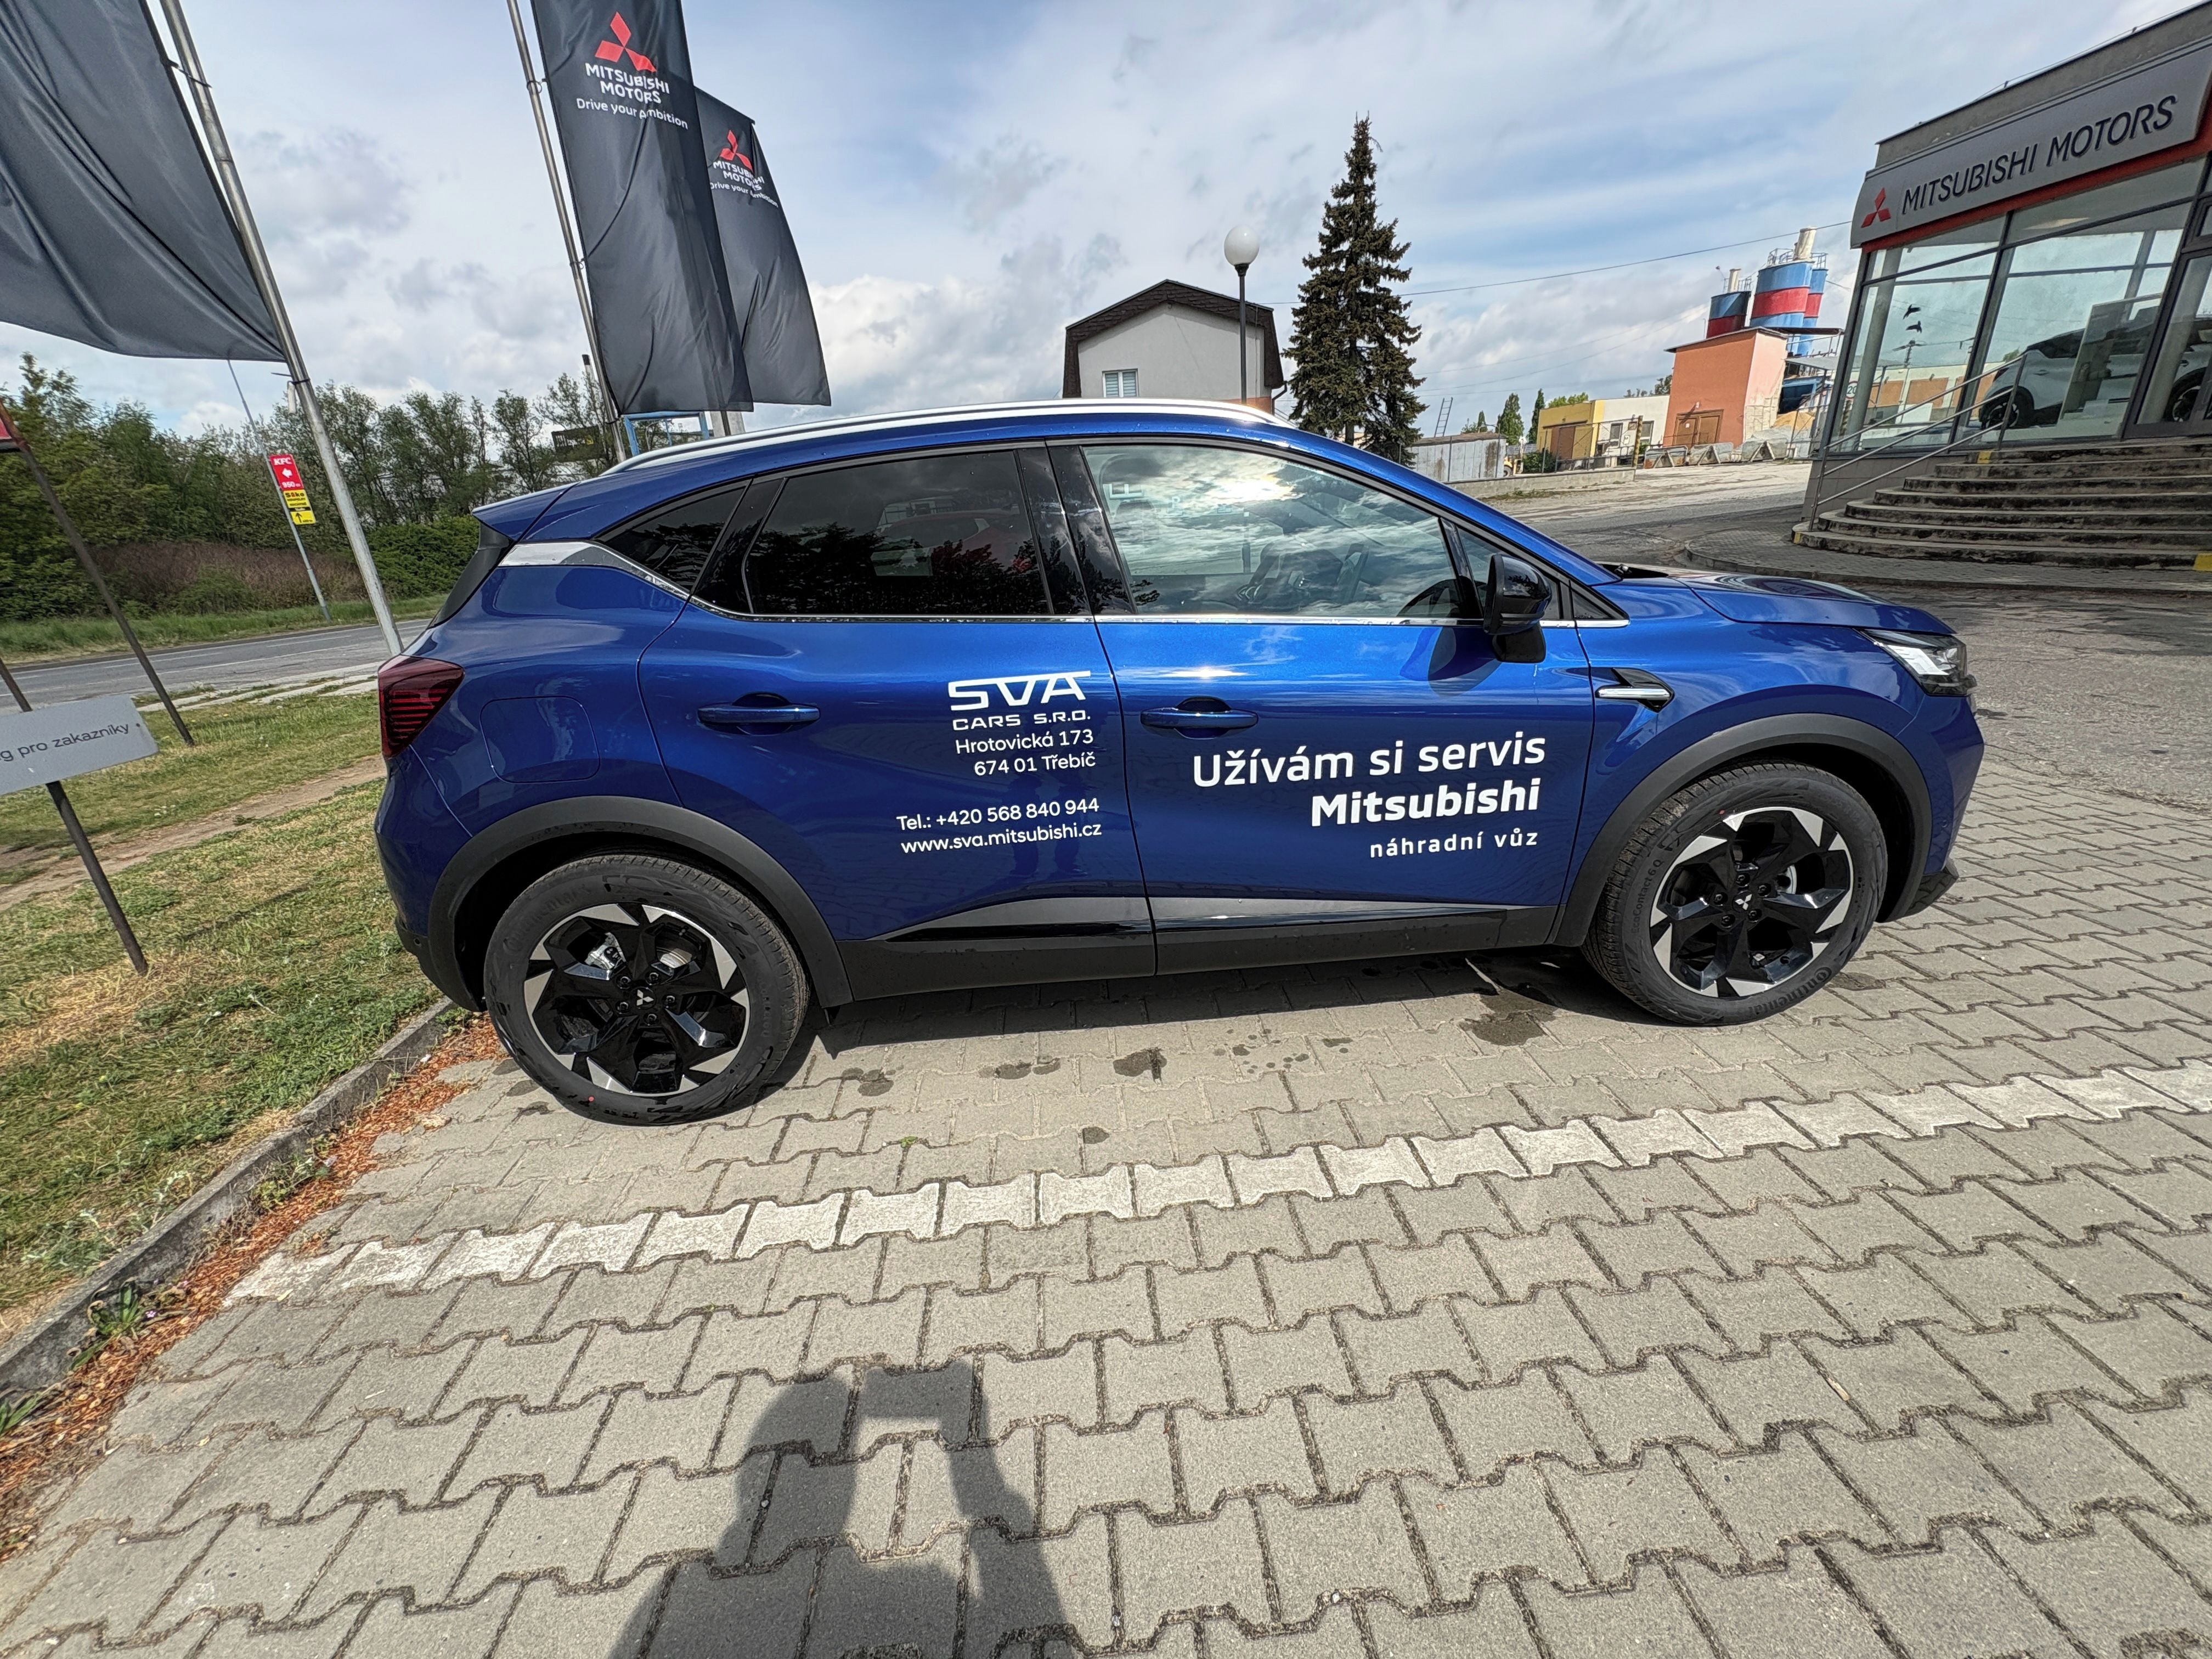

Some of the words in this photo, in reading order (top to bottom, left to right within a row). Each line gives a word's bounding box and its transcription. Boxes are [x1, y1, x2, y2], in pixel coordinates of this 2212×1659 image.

[585, 63, 670, 94] MITSUBISHI
[600, 81, 662, 104] MOTORS
[577, 98, 608, 111] Drive
[610, 103, 637, 117] your
[639, 109, 689, 129] Ambition
[1901, 142, 2040, 215] MITSUBISHI
[2046, 95, 2177, 167] MOTORS
[731, 184, 748, 194] your
[274, 457, 292, 465] KFC
[948, 670, 1091, 711] SVA
[952, 714, 1021, 731] CARS
[0, 749, 14, 761] g
[18, 742, 48, 758] pro
[52, 724, 128, 747] zakazniky
[956, 731, 1053, 754] Hrotovická
[1059, 729, 1093, 746] 173
[974, 759, 1009, 776] 674
[1014, 757, 1037, 772] 01
[1041, 751, 1096, 770] Třebíč
[1194, 746, 1353, 787] Užívám
[1369, 740, 1403, 776] si
[1418, 731, 1545, 772] servis
[896, 814, 932, 831] Tel.:
[936, 809, 982, 825] +420
[988, 805, 1022, 822] 568
[1026, 802, 1060, 819] 840
[1065, 798, 1099, 815] 944
[1312, 777, 1541, 827] Mitsubishi
[901, 822, 1102, 853] www.sva.mitsubishi.cz
[1370, 831, 1483, 858] náhradní
[1494, 827, 1538, 848] vůz
[1632, 877, 1652, 933] EcoContact
[1748, 967, 1832, 1015] Continental
